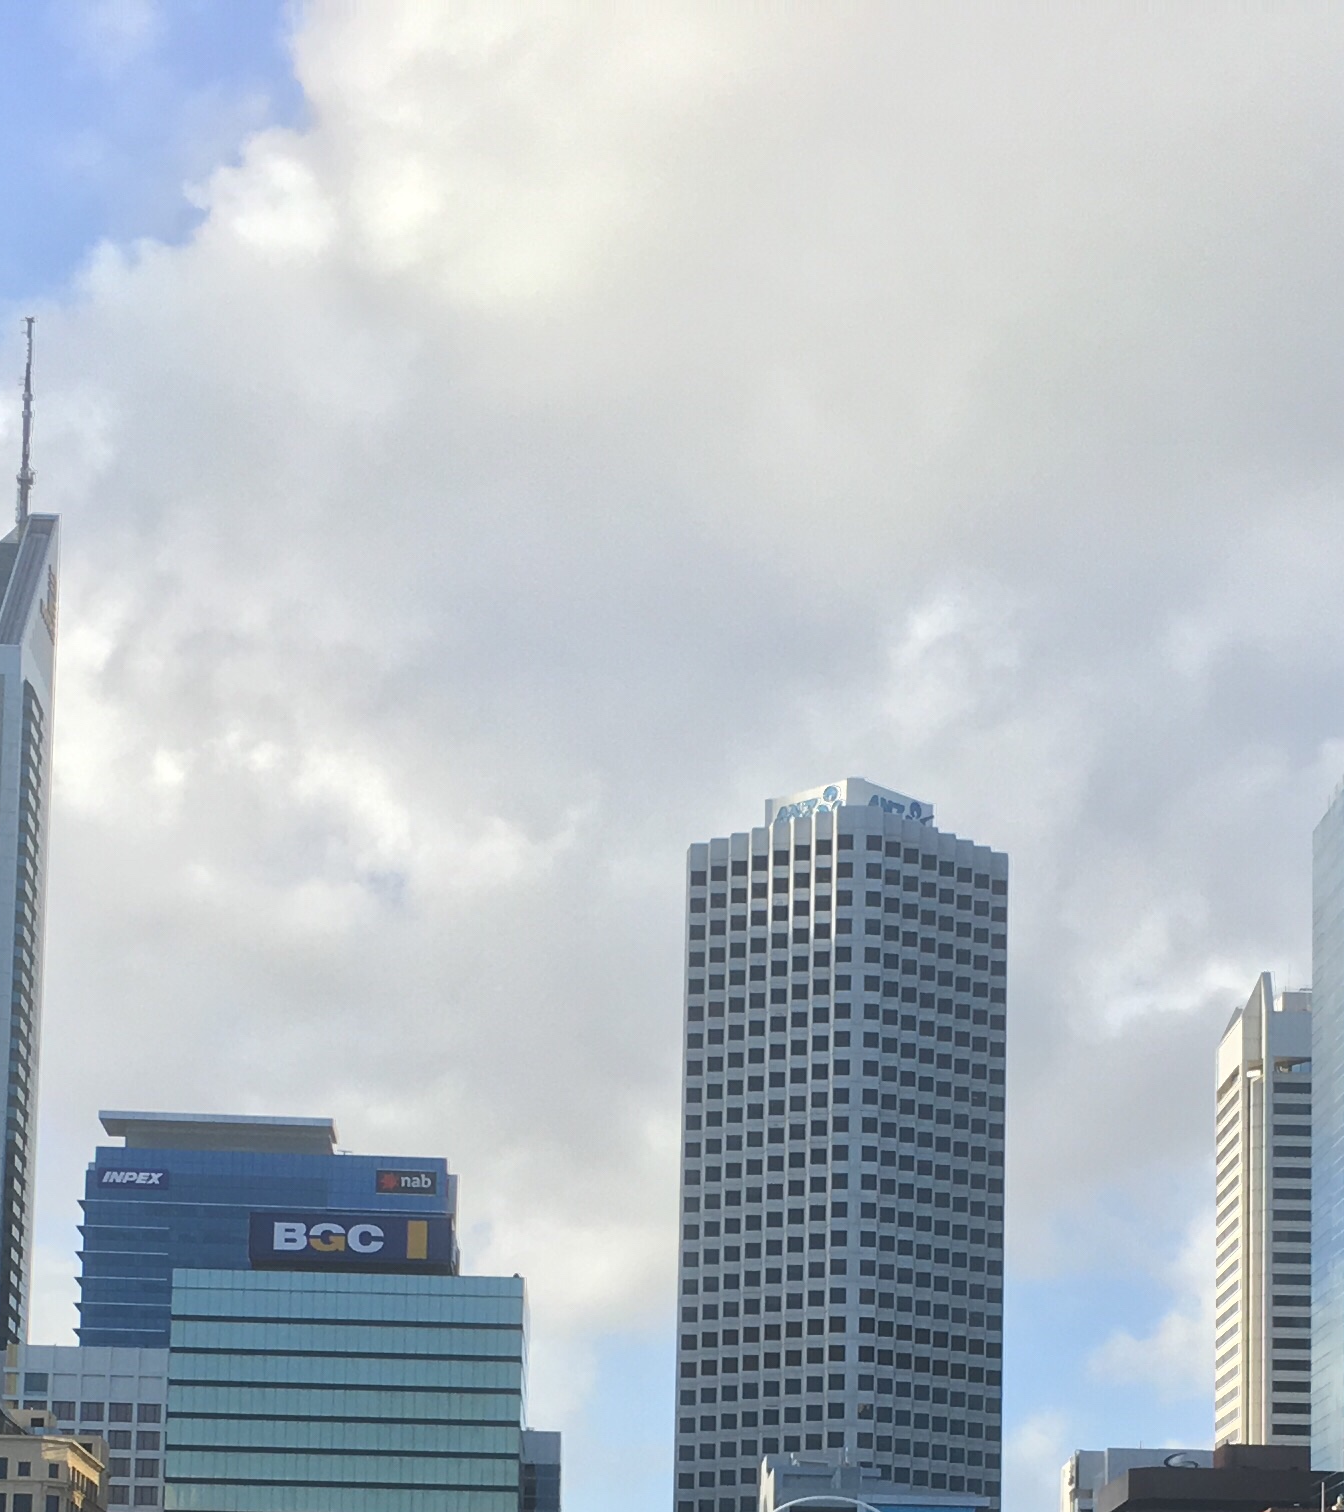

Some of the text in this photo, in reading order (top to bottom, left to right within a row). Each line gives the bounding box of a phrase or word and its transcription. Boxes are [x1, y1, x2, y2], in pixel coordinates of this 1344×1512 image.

[101, 1171, 164, 1185] INPEX
[400, 1173, 432, 1189] nab
[273, 1221, 385, 1254] BGC
